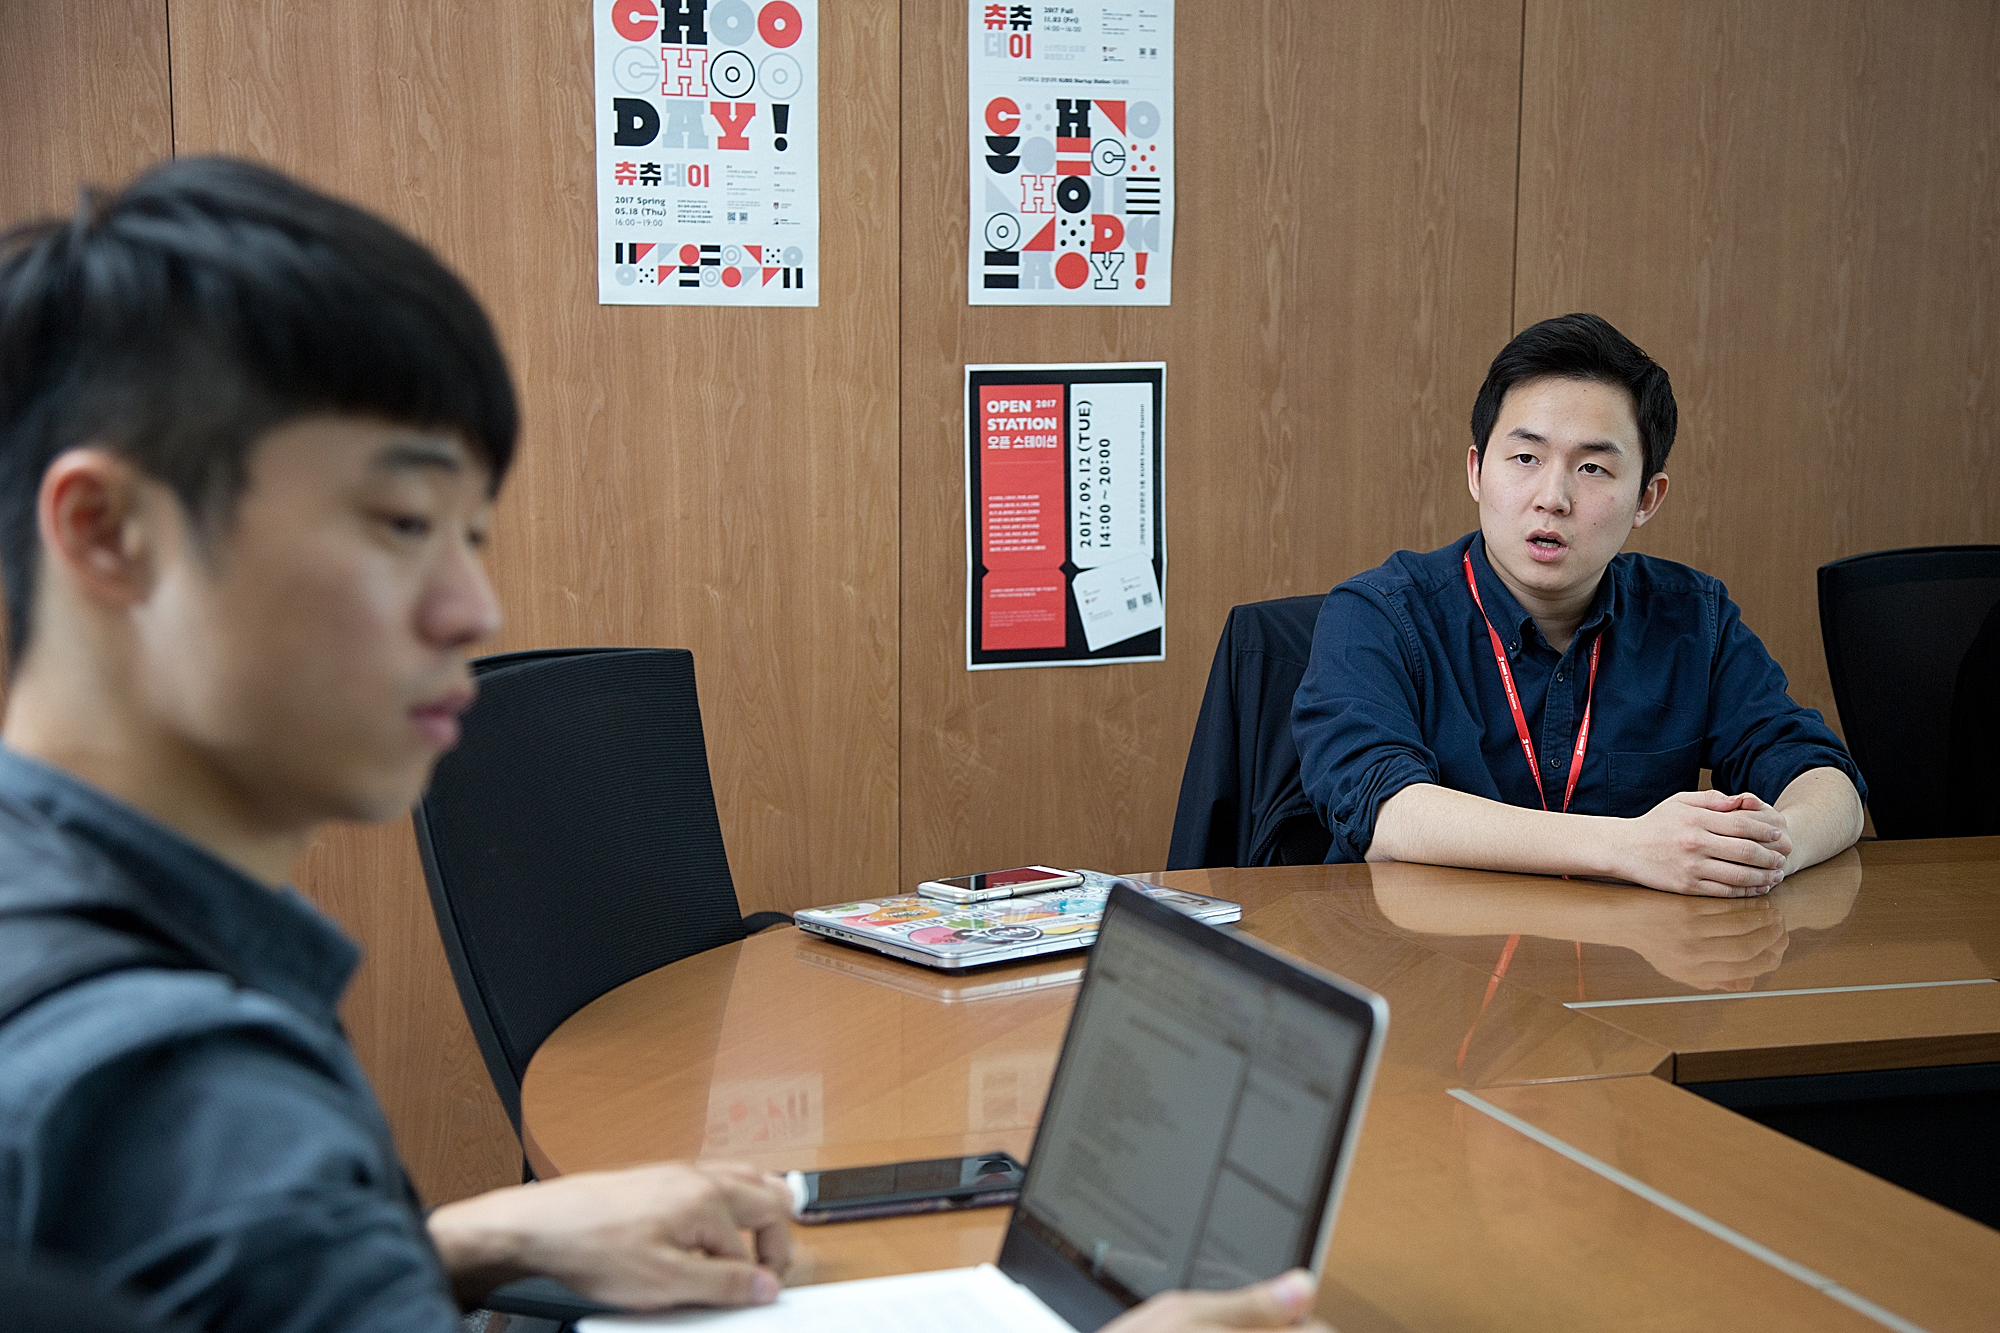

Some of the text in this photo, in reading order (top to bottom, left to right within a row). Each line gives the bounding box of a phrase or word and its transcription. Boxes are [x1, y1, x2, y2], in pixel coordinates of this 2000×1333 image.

[984, 4, 1032, 31] 츄츄
[984, 33, 1032, 59] 데이
[613, 46, 803, 100] CHOO
[613, 97, 790, 151] DAY!
[615, 196, 634, 205] 2017
[637, 197, 666, 207] Spring
[615, 208, 666, 217] 05.18 (Thu)
[987, 400, 1056, 413] OPEN 2017
[987, 417, 1057, 431] STATION
[1013, 435, 1057, 448] 스테이션
